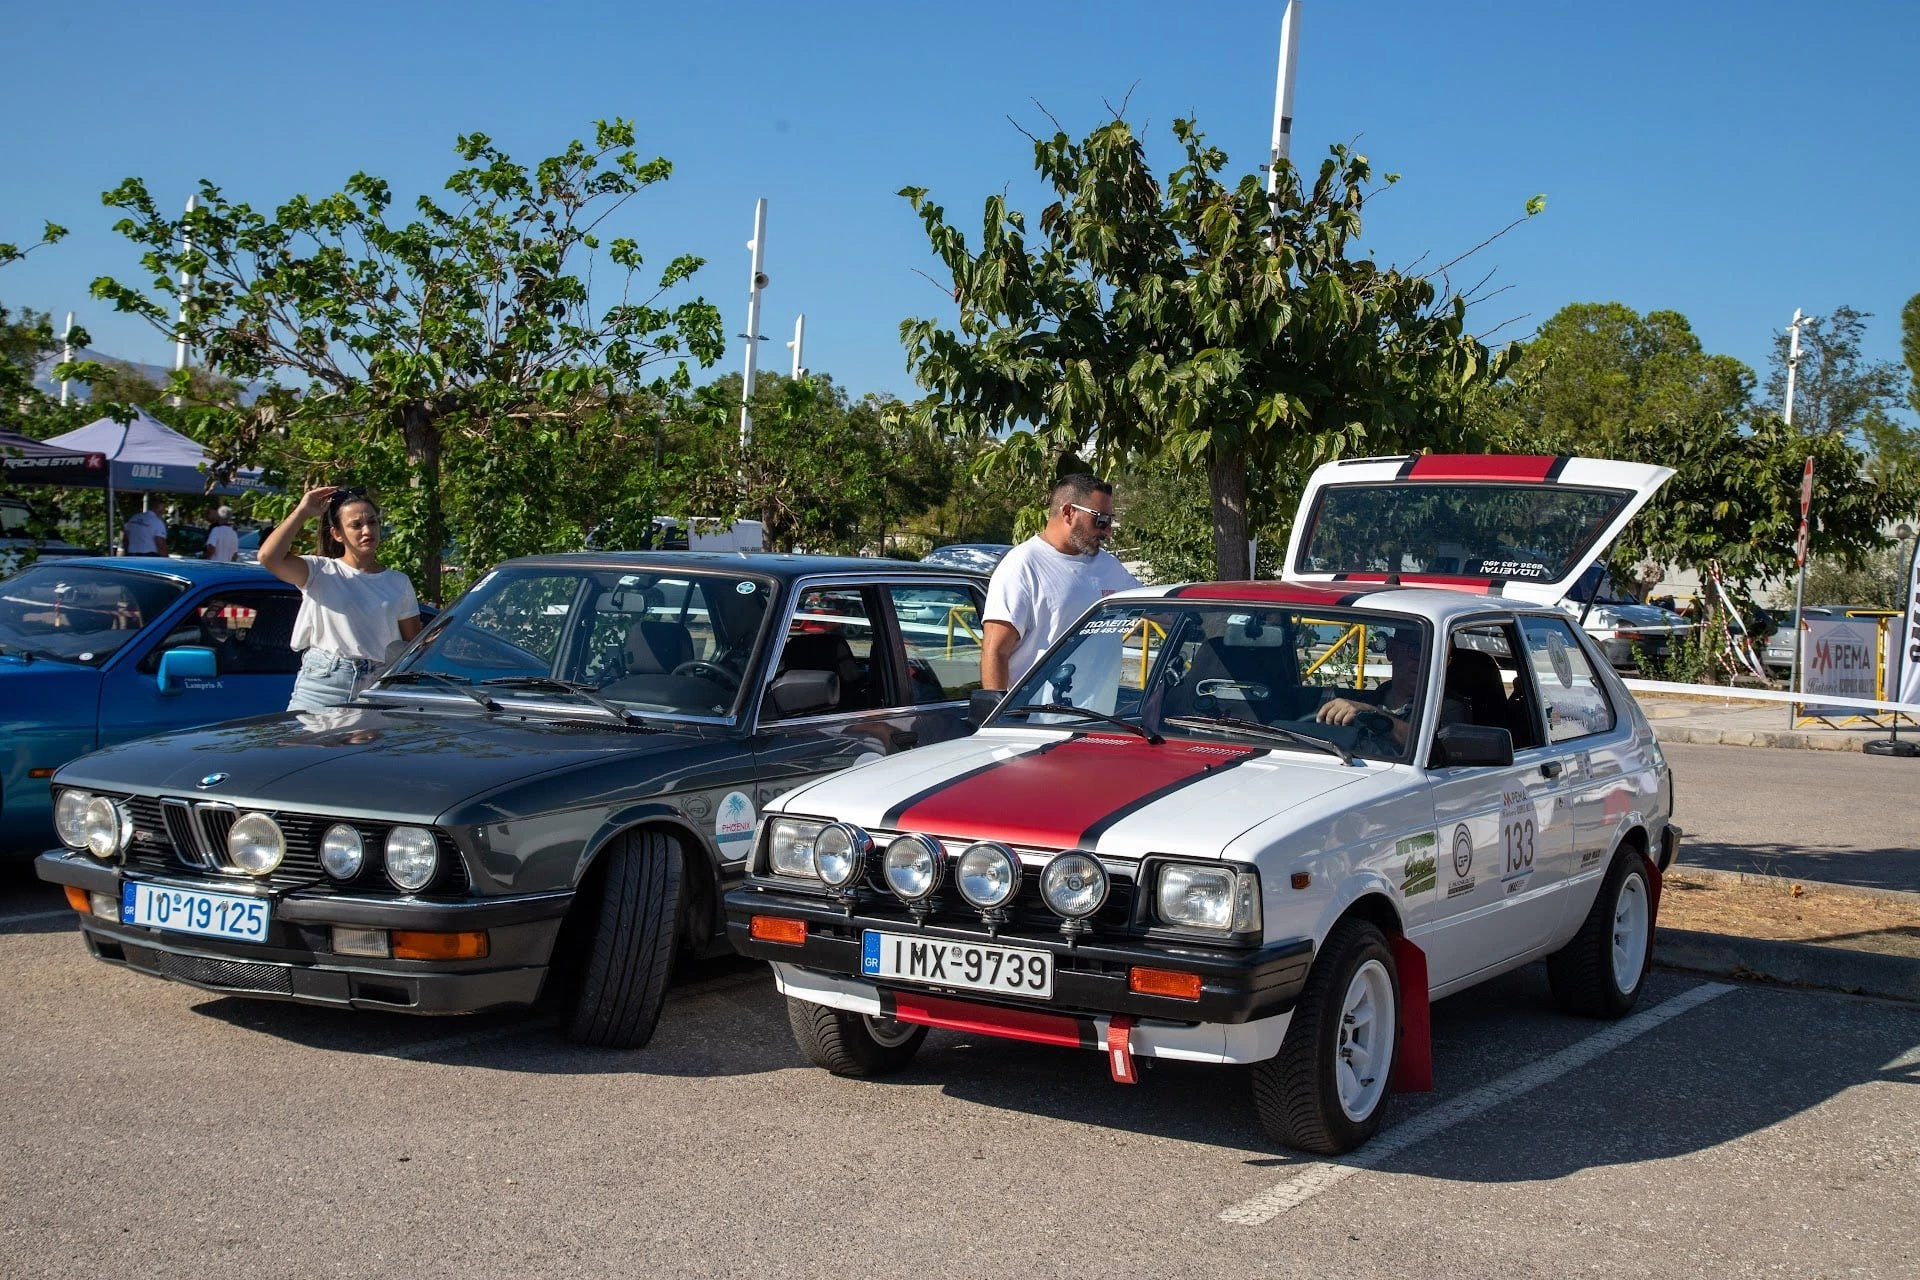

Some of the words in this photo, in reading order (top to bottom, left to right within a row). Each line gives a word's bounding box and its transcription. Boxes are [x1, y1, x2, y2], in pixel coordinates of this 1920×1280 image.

[1479, 566, 1541, 577] ΠΩΛΕΙΤΑΙ
[1834, 644, 1871, 670] PEMA
[721, 822, 751, 833] PHOENIX
[1504, 818, 1534, 873] 133
[124, 906, 135, 915] GR
[864, 957, 878, 968] GR
[895, 940, 1047, 991] IMX-9739
